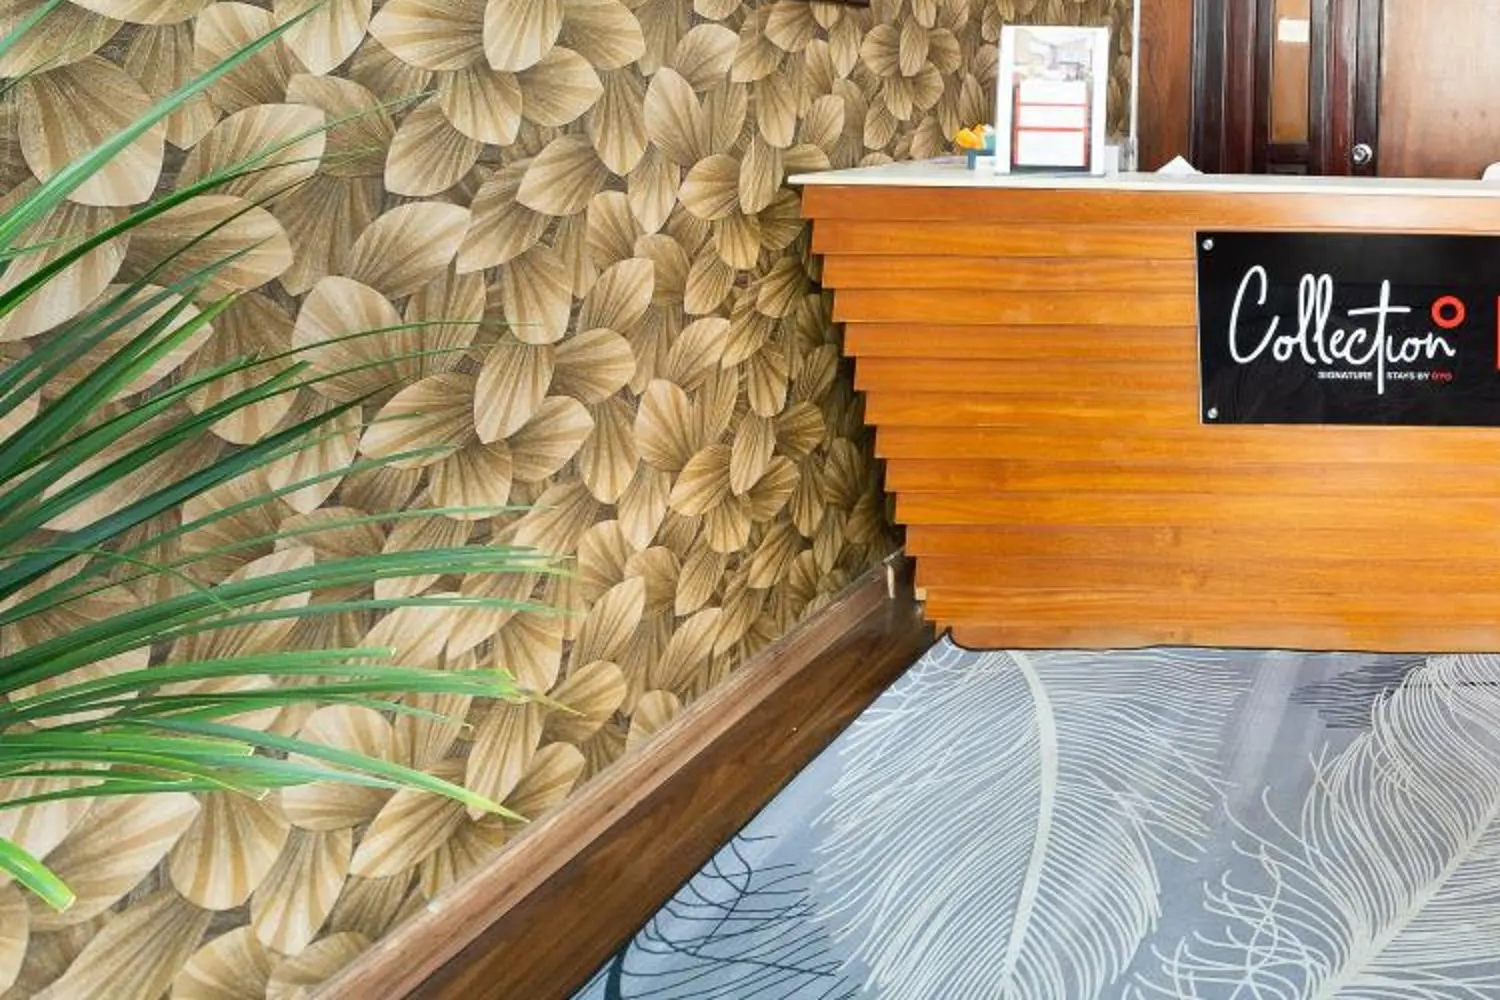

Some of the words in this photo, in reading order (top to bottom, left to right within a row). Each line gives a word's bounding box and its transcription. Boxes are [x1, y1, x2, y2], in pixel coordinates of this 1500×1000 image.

[1228, 265, 1457, 395] Collection
[1317, 371, 1374, 380] SIGNATURE
[1386, 371, 1416, 381] STAYS
[1417, 372, 1430, 381] BY
